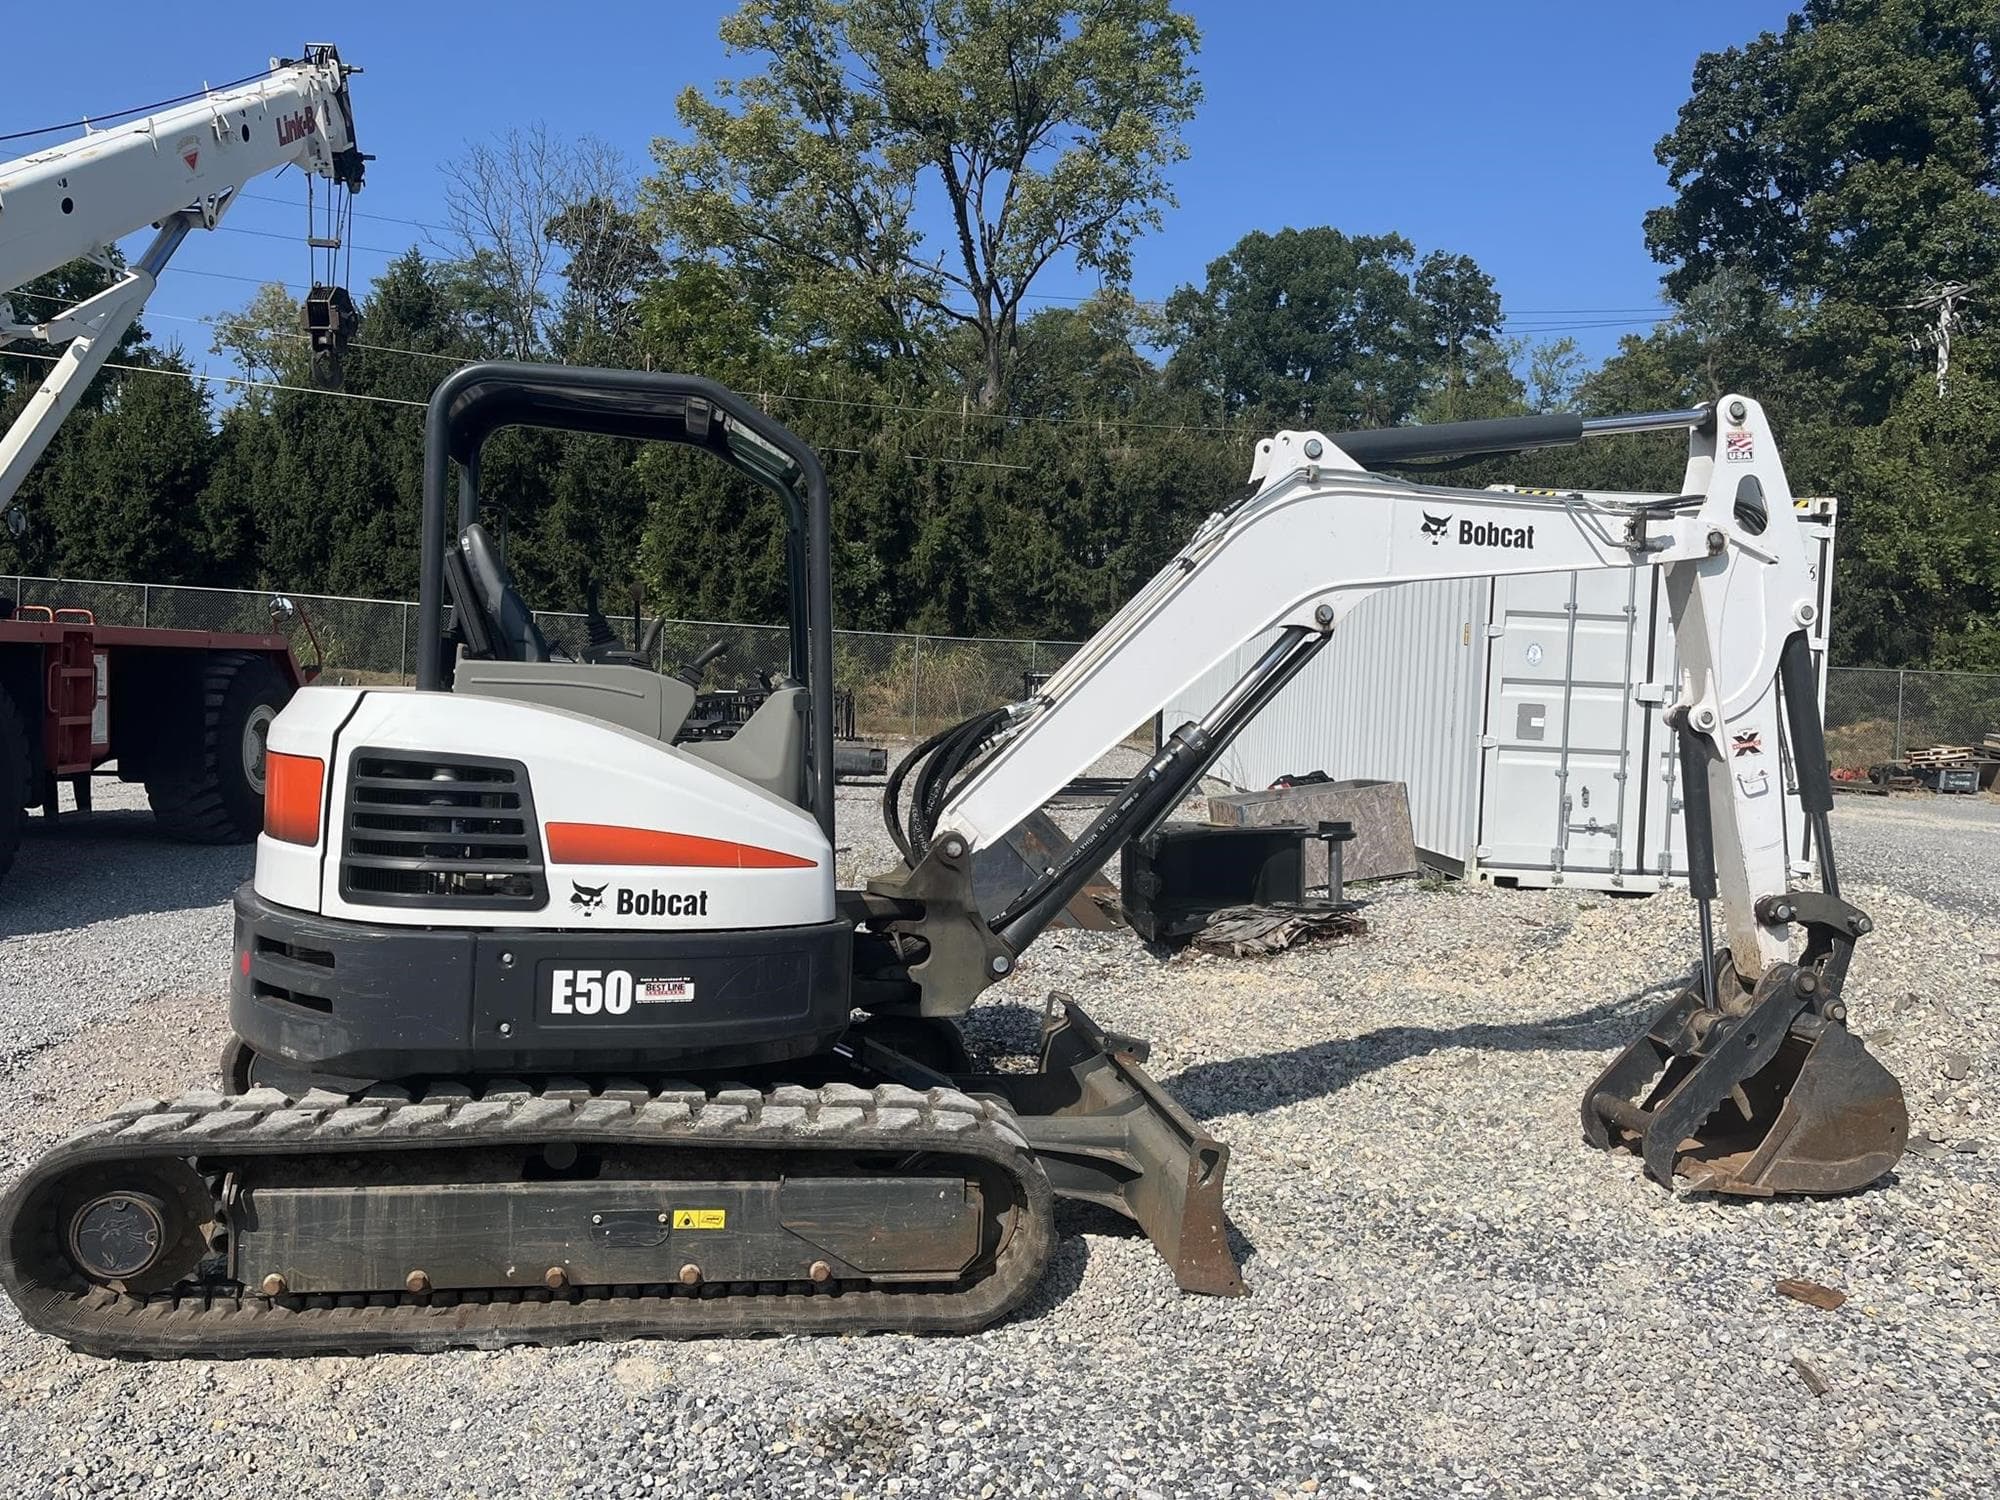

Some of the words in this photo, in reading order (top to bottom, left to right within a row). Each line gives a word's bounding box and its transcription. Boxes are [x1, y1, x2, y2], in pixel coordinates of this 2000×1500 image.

[1459, 520, 1535, 549] Bobcat
[616, 889, 708, 916] Bobcat
[551, 970, 633, 1014] E50
[646, 983, 665, 991] BEST
[667, 983, 685, 991] LINE
